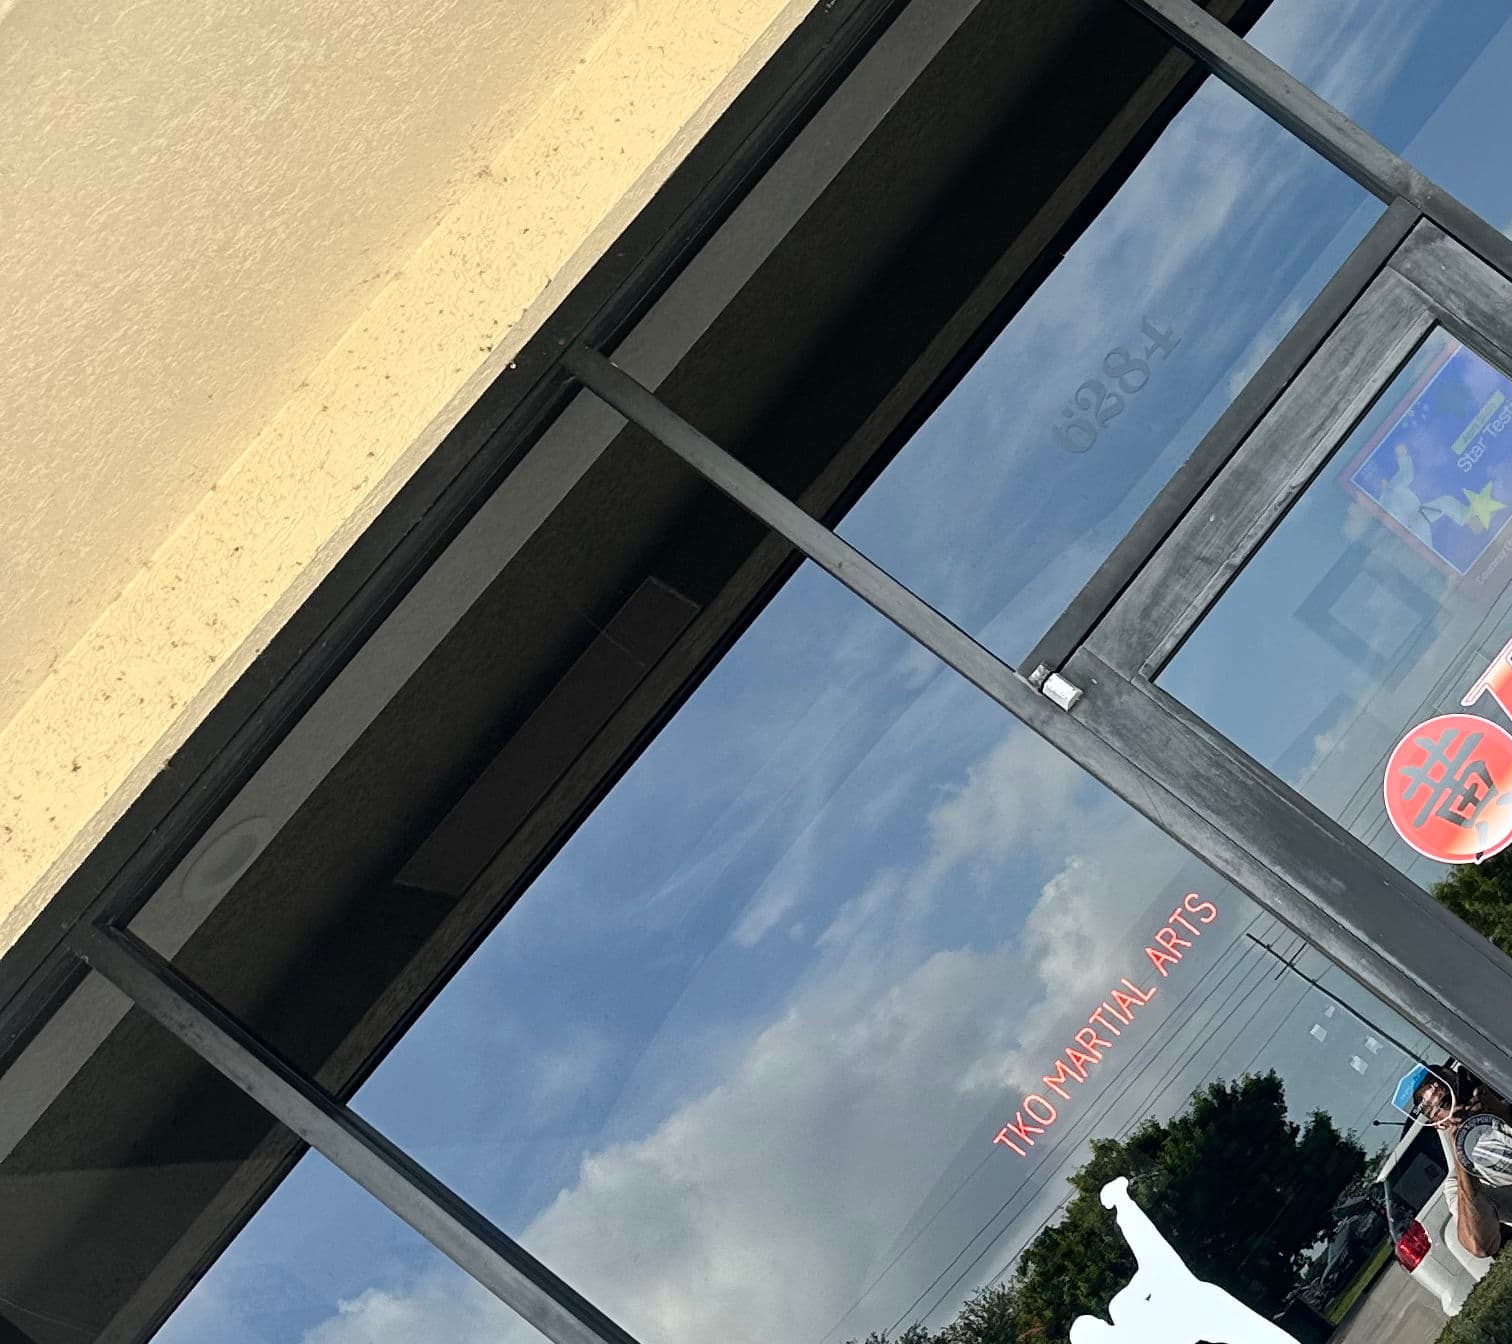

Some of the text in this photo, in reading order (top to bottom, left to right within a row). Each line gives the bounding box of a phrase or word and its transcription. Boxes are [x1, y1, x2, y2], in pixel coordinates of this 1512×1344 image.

[1457, 437, 1488, 473] Star
[993, 892, 1217, 1157] TKO MARTIAL ARTS
